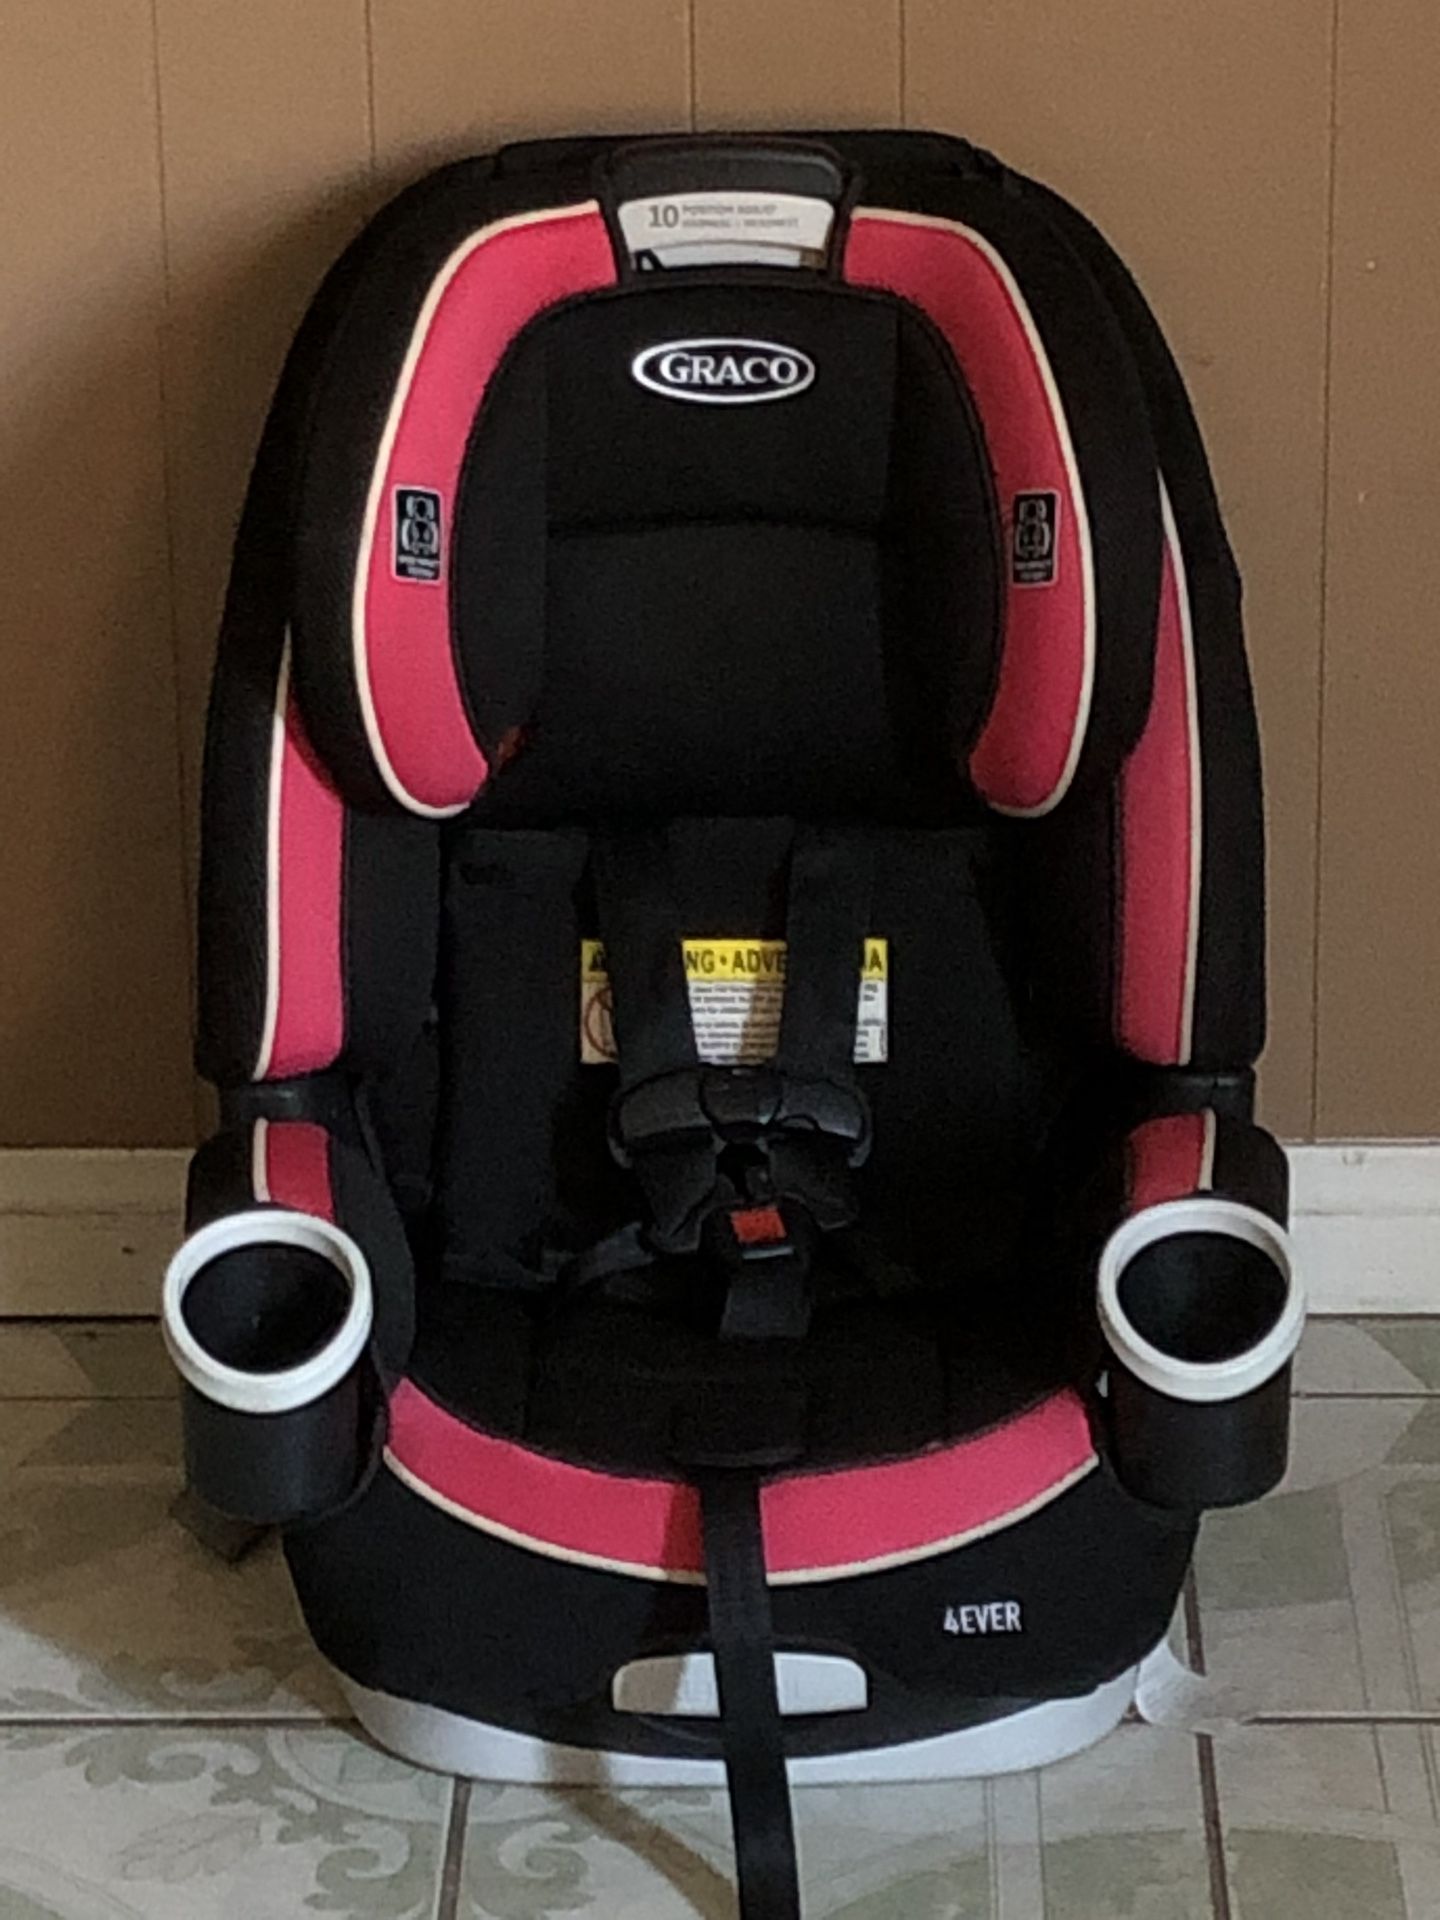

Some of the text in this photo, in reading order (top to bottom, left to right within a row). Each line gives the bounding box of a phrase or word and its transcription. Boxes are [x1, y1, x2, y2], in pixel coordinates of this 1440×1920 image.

[649, 205, 680, 228] 10
[659, 352, 799, 386] GRACO
[943, 1601, 1022, 1635] 4EVER
